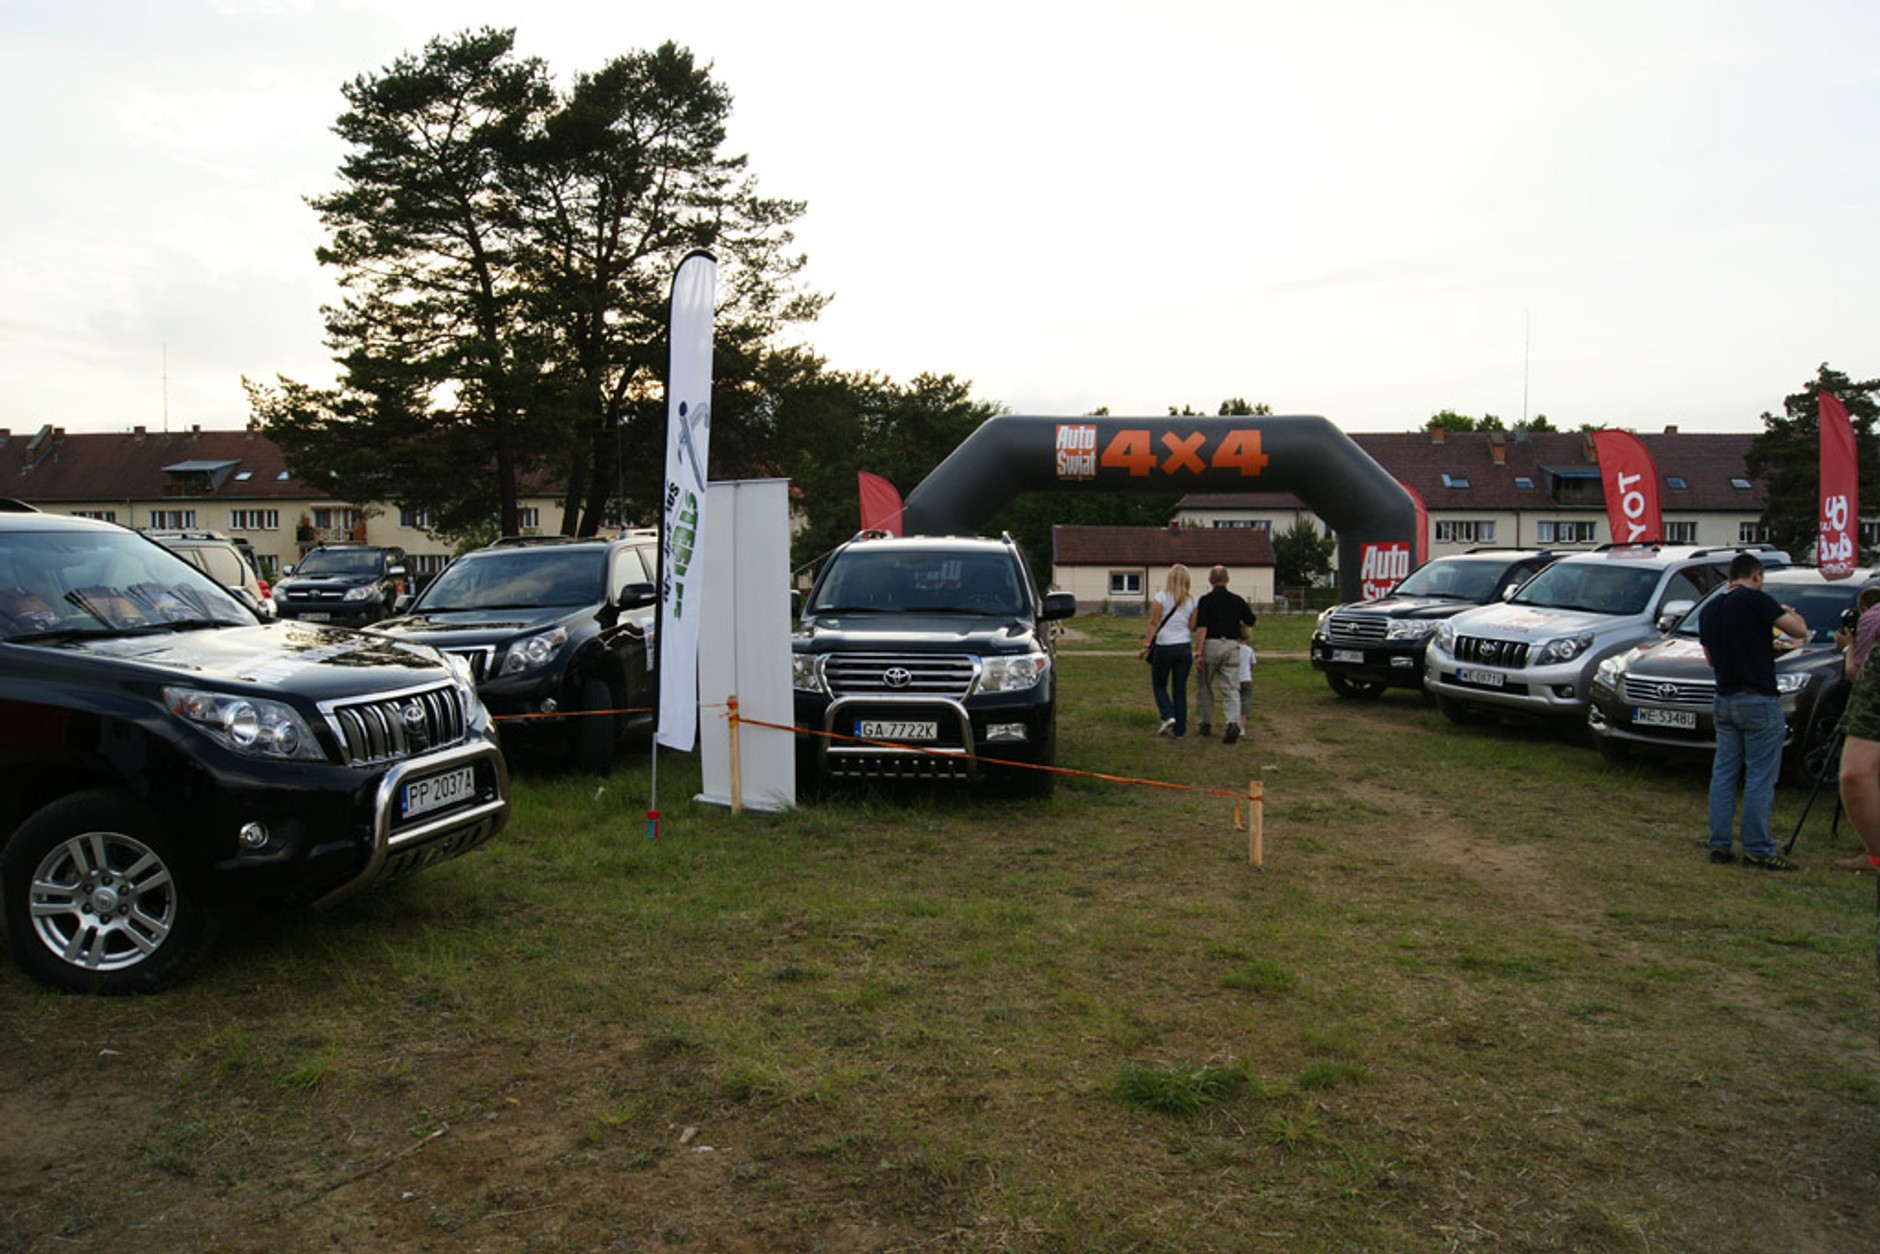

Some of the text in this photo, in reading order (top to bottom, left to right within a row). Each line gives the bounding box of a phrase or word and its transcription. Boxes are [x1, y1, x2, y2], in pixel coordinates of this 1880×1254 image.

[1056, 425, 1095, 449] Auto
[1101, 429, 1269, 477] 4x4
[1361, 544, 1409, 580] Auto
[863, 723, 934, 738] GA 7722K
[1639, 710, 1657, 723] WE
[409, 768, 473, 809] PP 2037A
